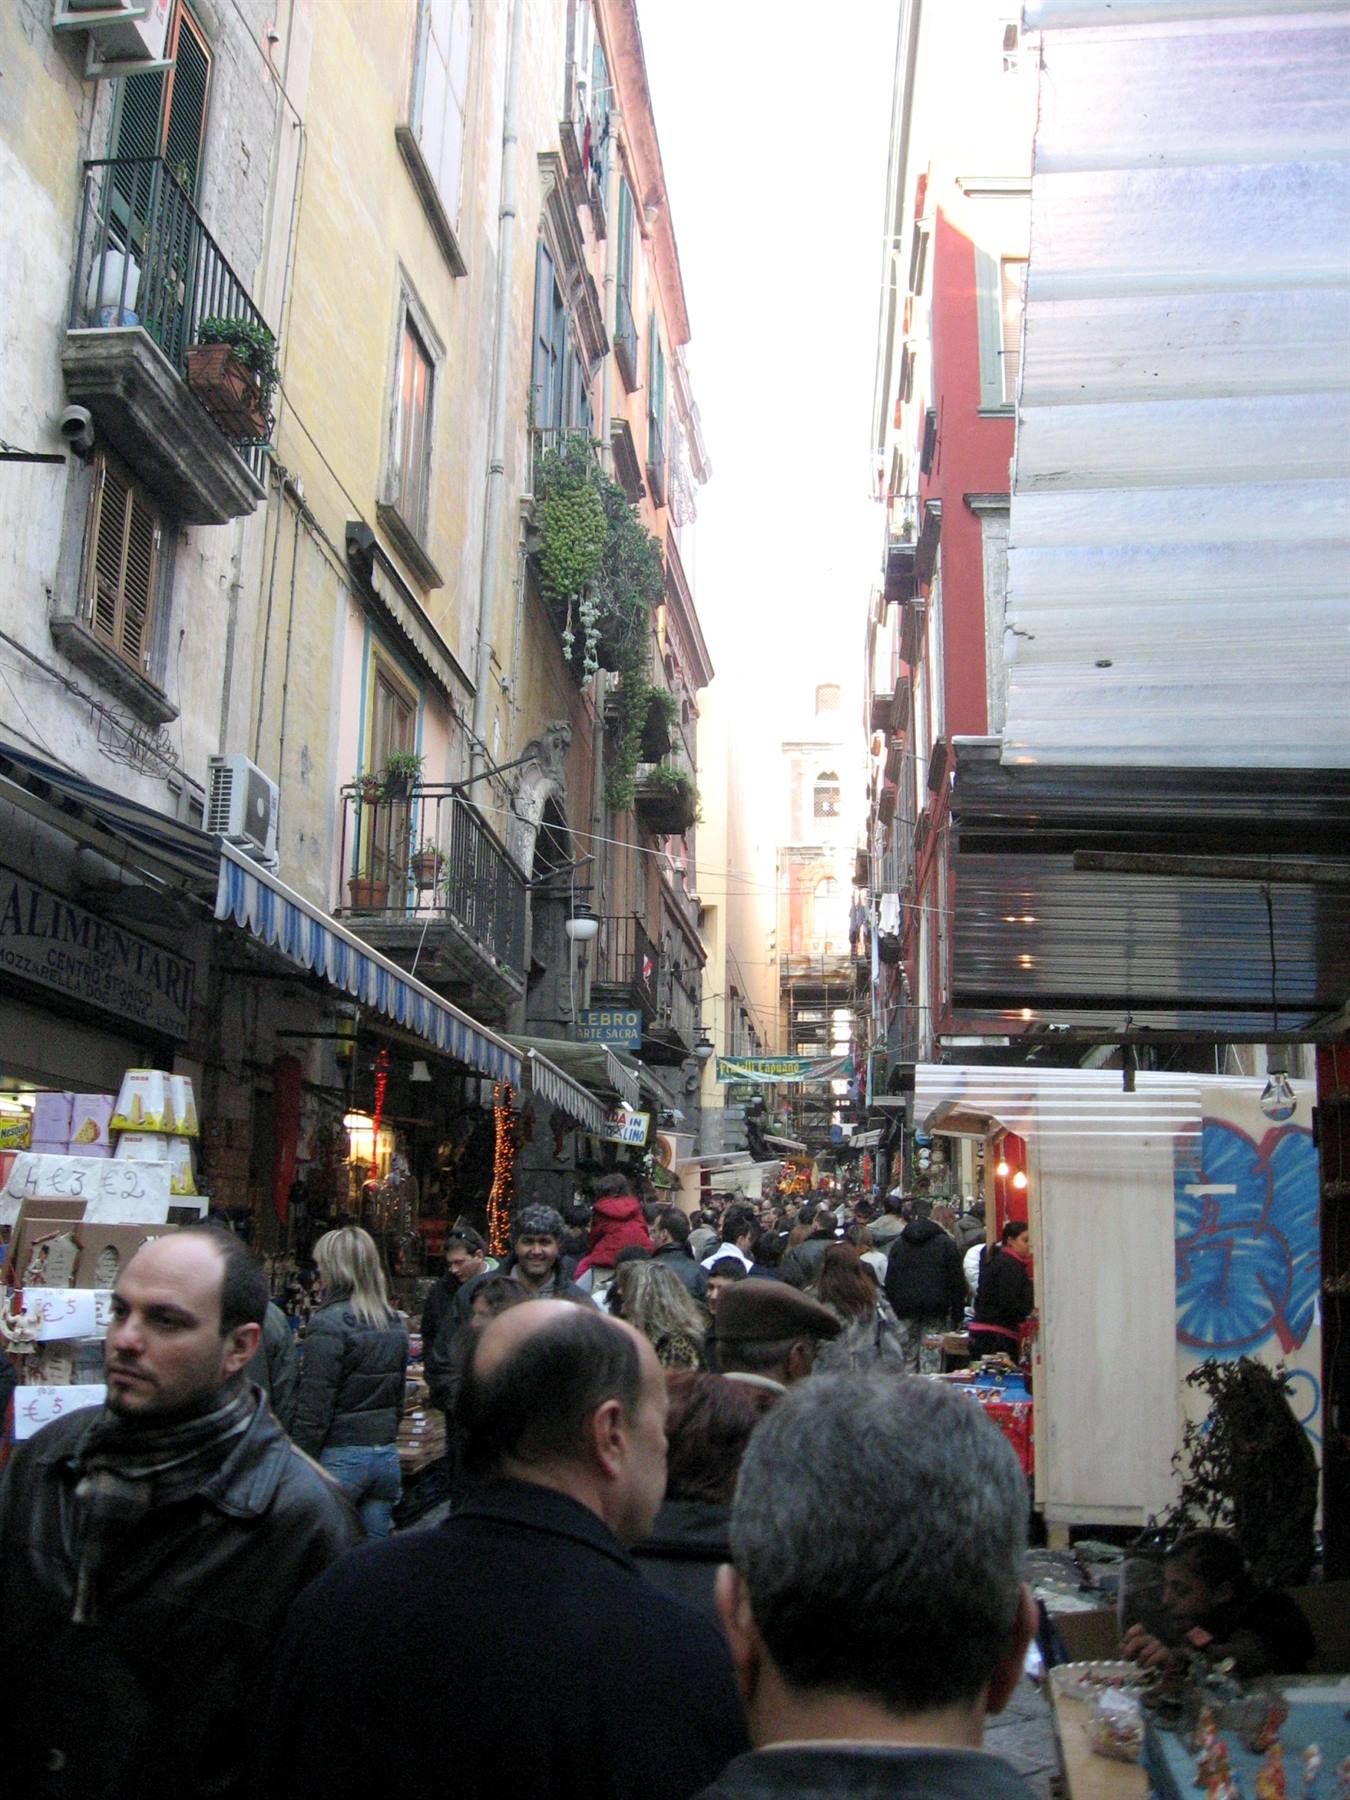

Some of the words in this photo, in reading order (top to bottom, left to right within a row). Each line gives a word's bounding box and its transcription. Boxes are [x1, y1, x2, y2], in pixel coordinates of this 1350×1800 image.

[0, 882, 191, 1015] ALIMENTARI
[47, 948, 101, 986] CENTRO
[576, 1028, 602, 1039] ARTE
[607, 1028, 638, 1039] SACRA
[630, 1117, 642, 1127] IN
[623, 1128, 645, 1142] LINO
